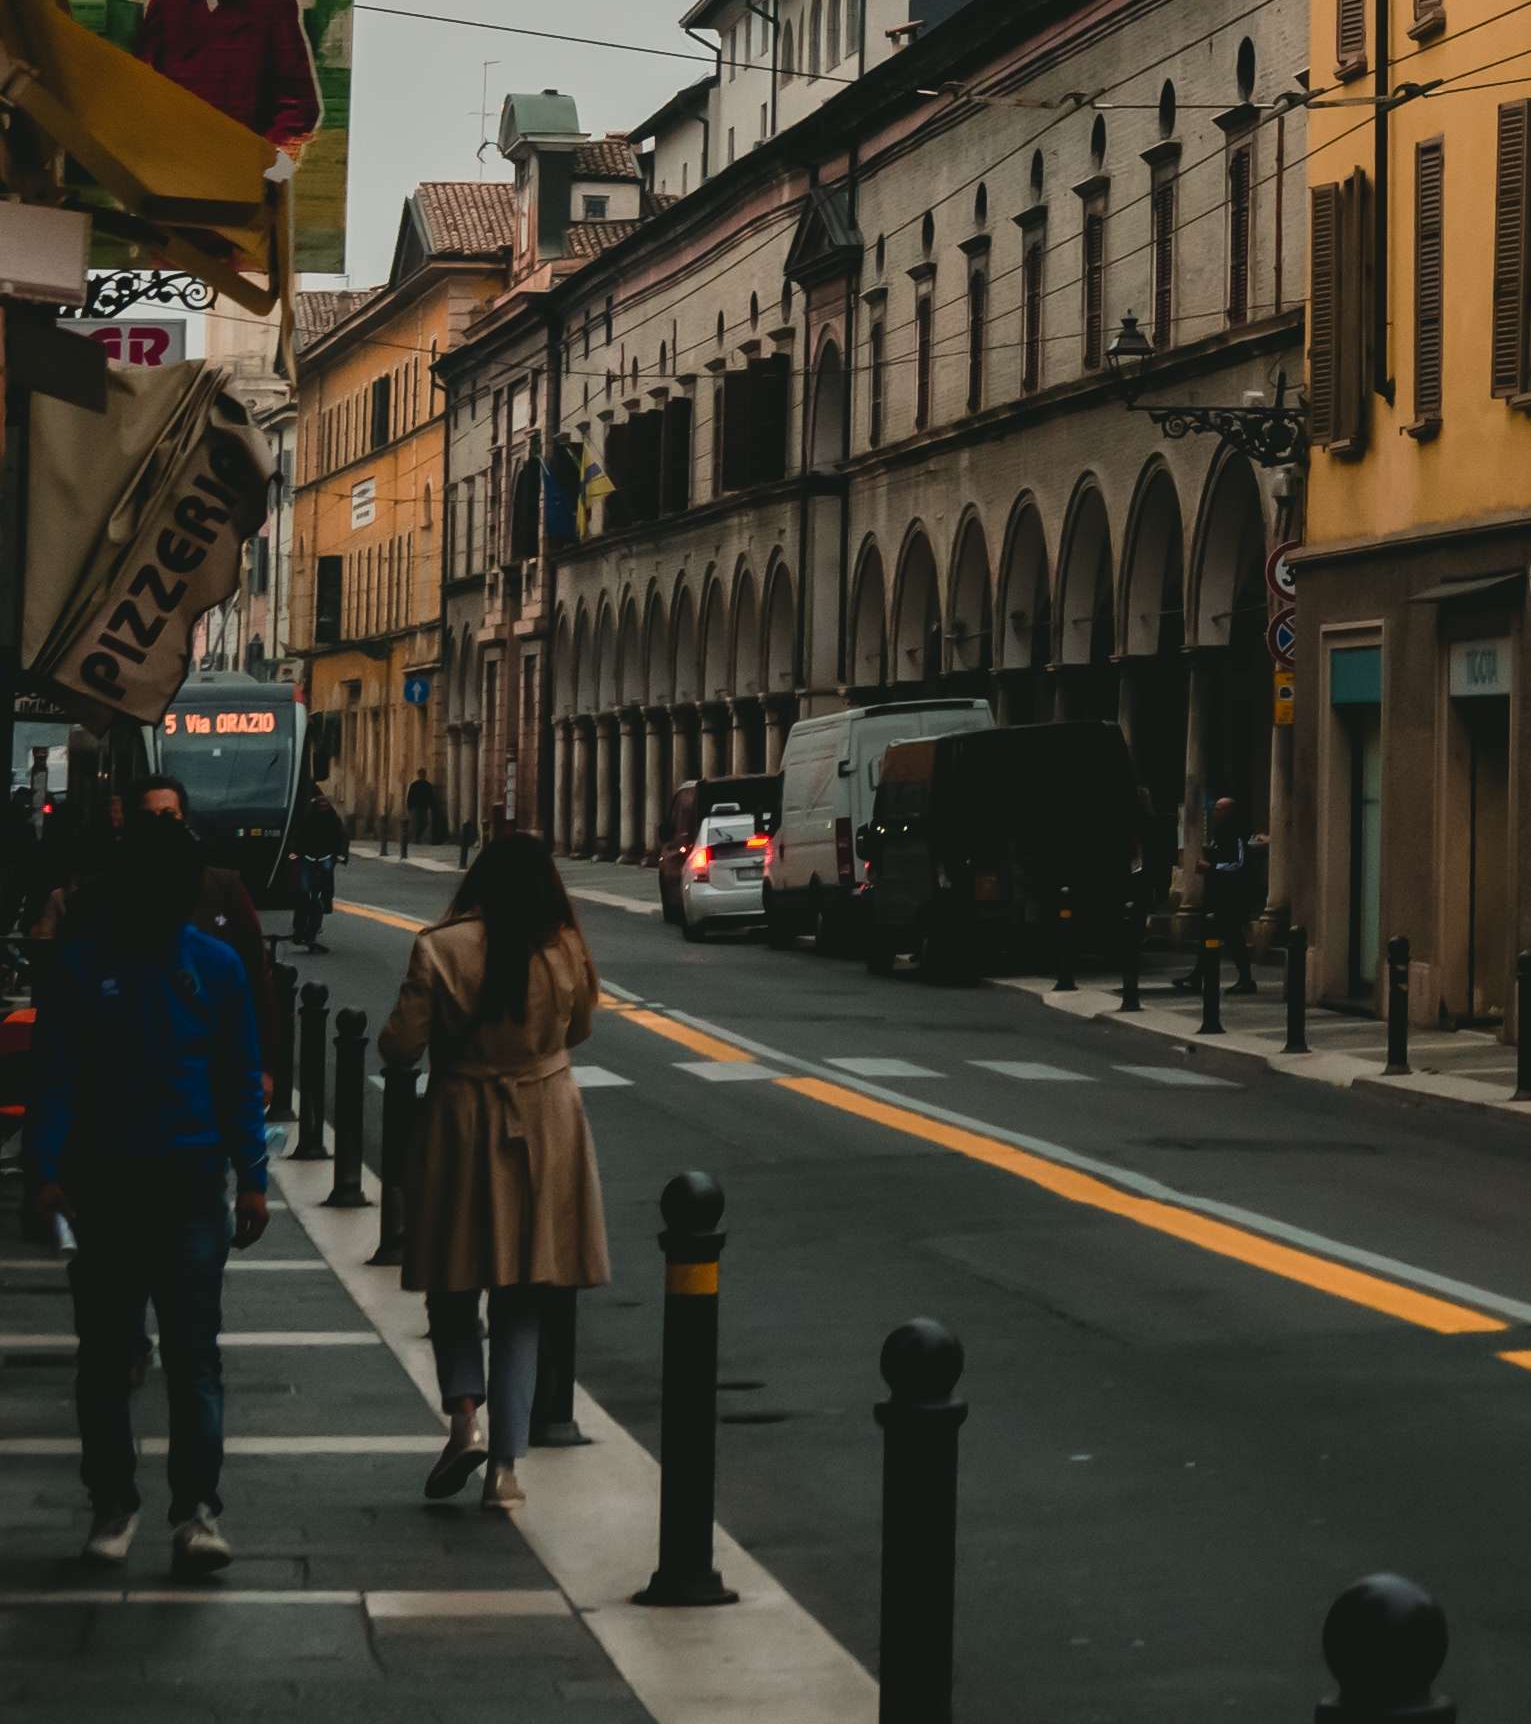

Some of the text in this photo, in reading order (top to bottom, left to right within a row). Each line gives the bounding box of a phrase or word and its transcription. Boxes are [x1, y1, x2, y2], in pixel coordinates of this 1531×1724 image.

[164, 711, 276, 735] 5 Via ORAZIO
